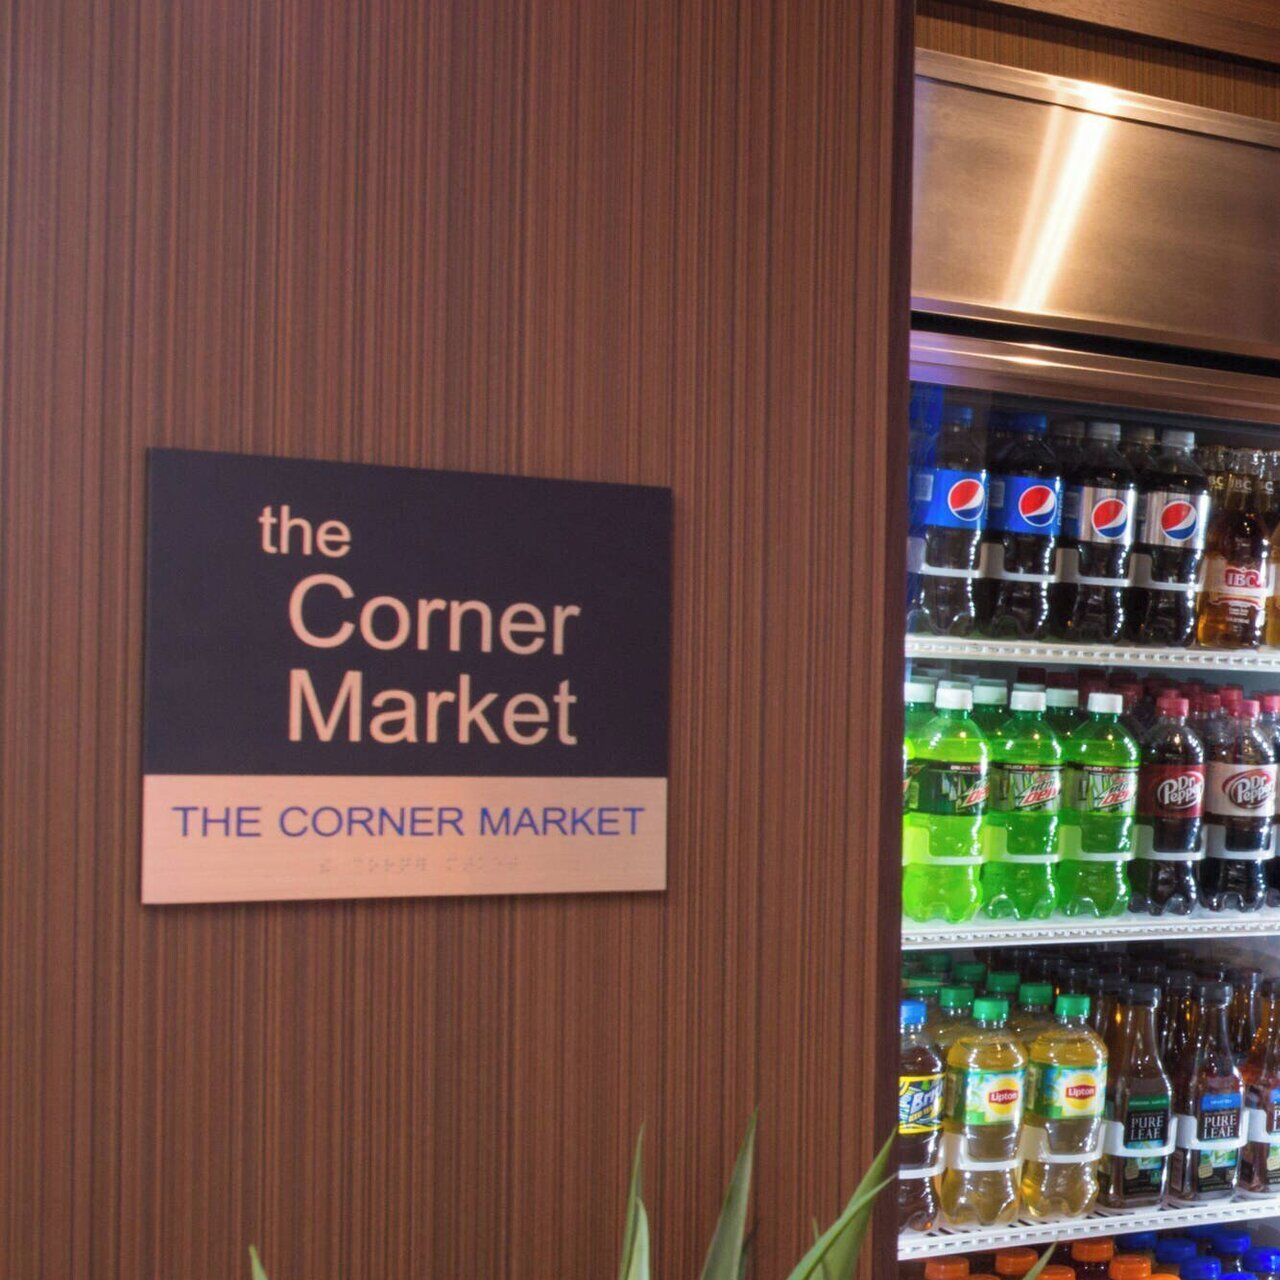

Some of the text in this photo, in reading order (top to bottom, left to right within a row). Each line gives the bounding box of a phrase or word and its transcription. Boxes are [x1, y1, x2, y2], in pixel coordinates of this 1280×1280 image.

[259, 505, 351, 558] the
[289, 573, 580, 656] Corner
[288, 669, 578, 745] Market
[1178, 775, 1194, 791] Dr
[1251, 775, 1267, 789] Dr
[172, 806, 646, 837] THE CORNER MARKET
[989, 1091, 1019, 1103] Lipton
[1067, 1085, 1096, 1097] Lipton
[1131, 1116, 1164, 1129] PURE
[1204, 1114, 1237, 1129] PURE
[1130, 1128, 1161, 1141] LEAF
[1203, 1127, 1234, 1140] LEAF
